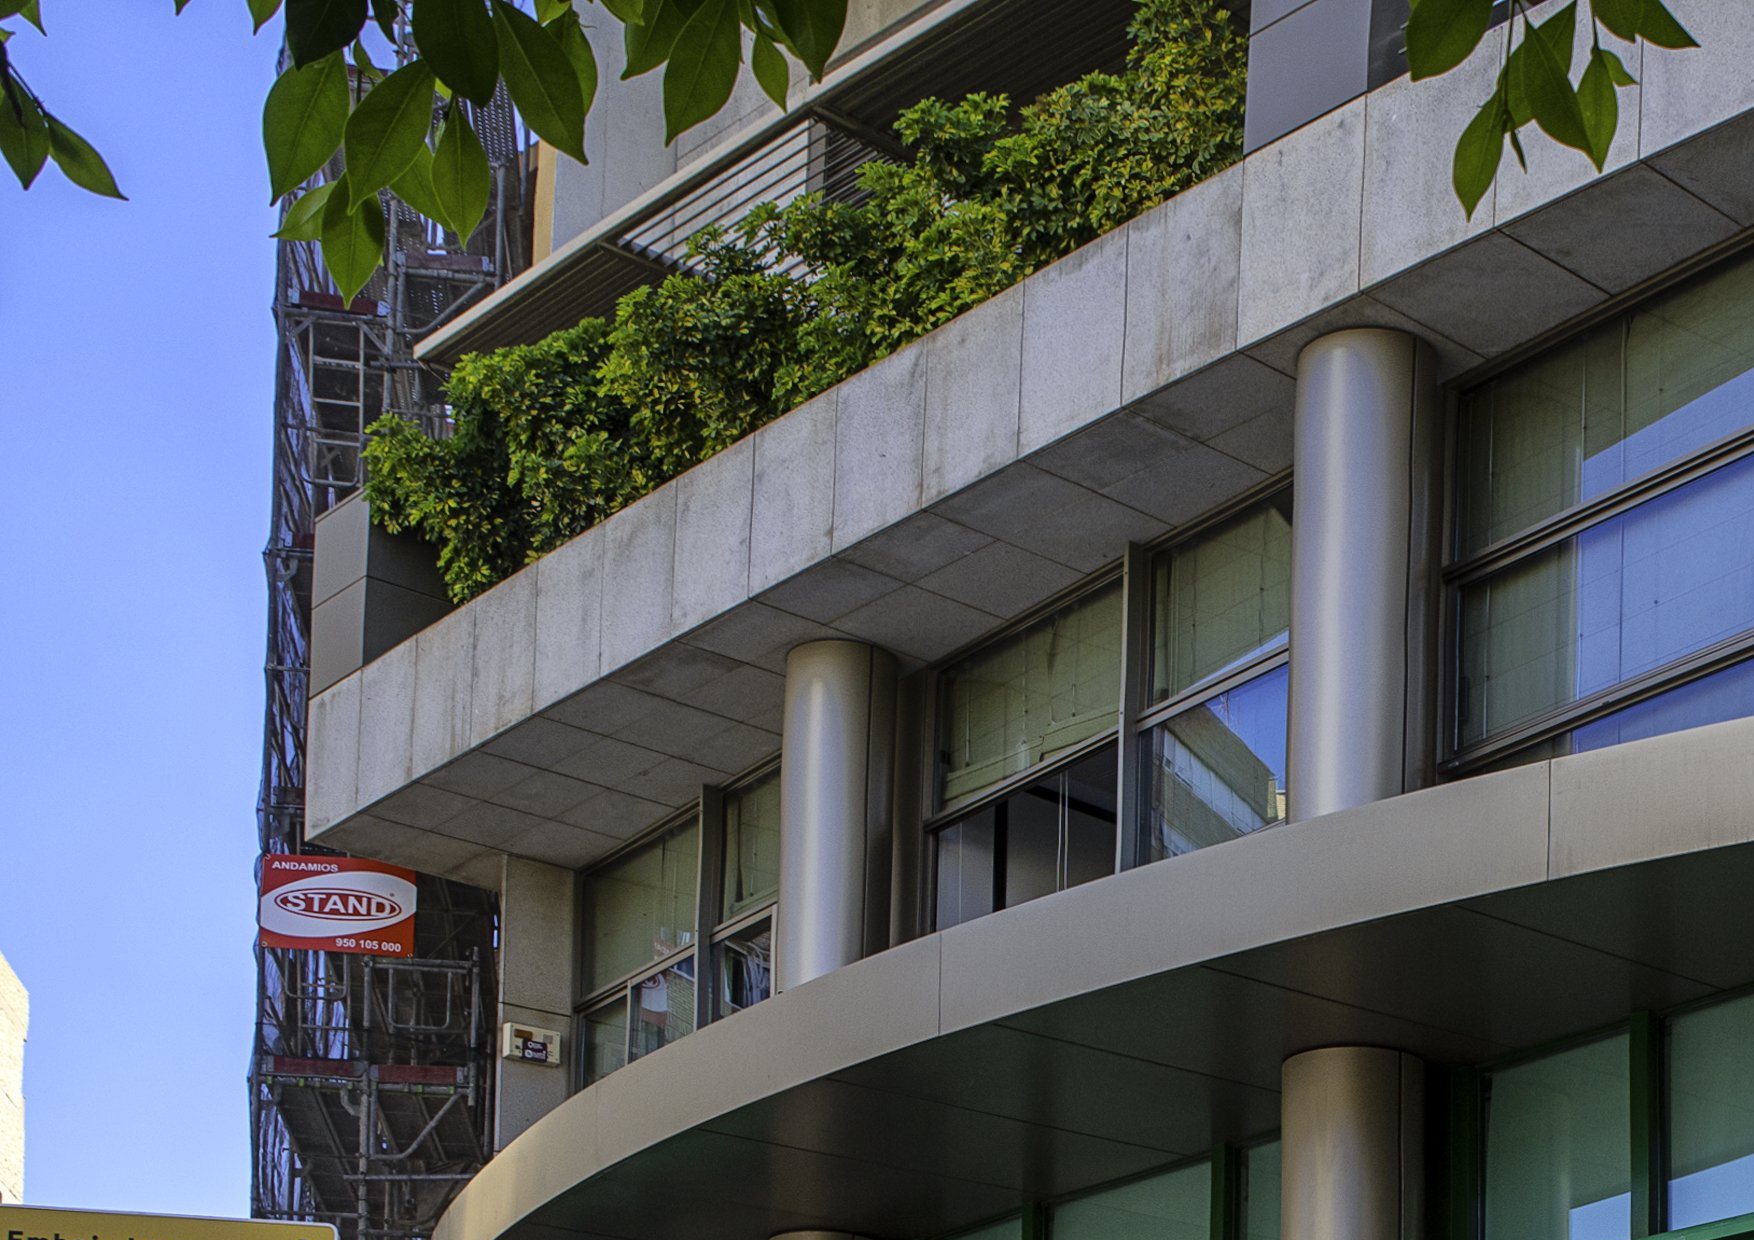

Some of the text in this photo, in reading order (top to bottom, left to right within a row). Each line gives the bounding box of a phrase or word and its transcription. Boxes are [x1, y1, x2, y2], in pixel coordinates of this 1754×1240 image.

[271, 860, 339, 873] ANDAMIOS
[285, 892, 390, 917] STAND
[335, 937, 402, 952] 950 105 000
